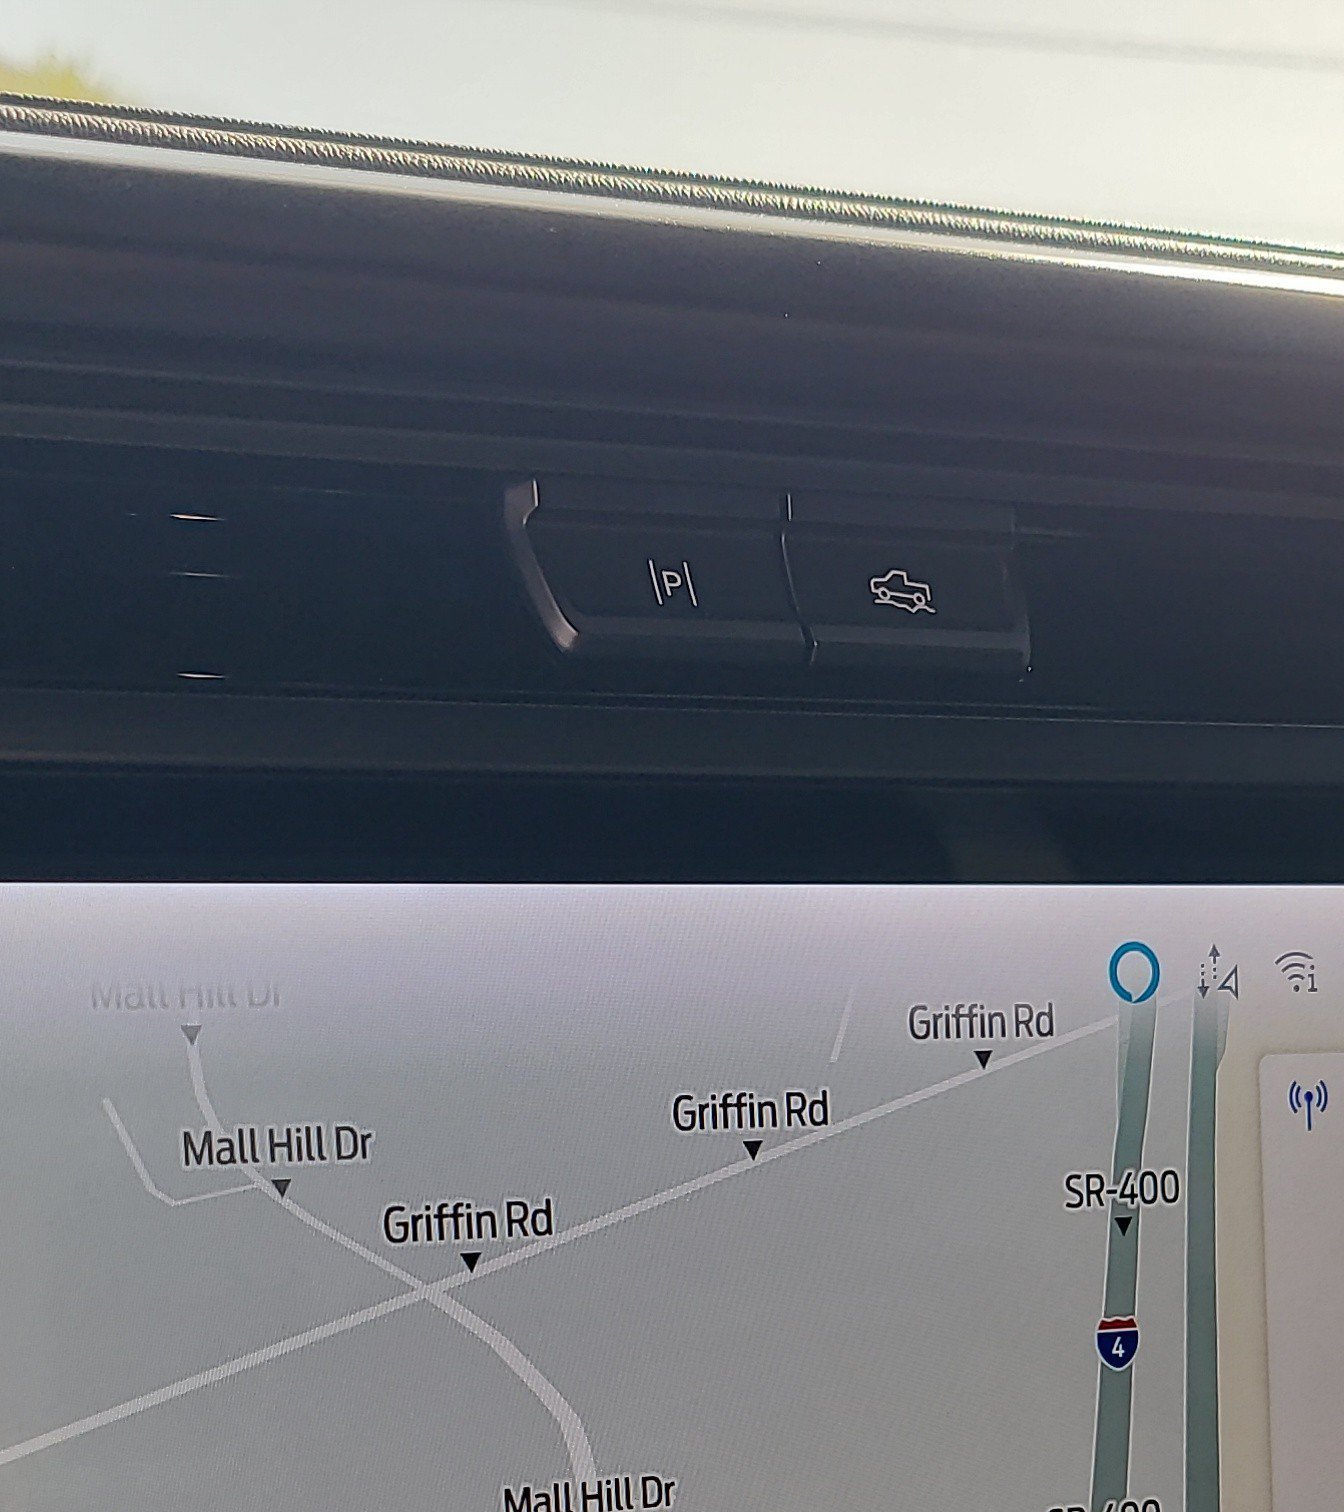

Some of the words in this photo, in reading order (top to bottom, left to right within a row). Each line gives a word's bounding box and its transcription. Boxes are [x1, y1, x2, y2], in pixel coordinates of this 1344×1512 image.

[907, 1003, 1008, 1041] Griffin
[1014, 1002, 1055, 1038] Rd
[672, 1093, 778, 1131] Griffin
[785, 1090, 830, 1128] Rd
[182, 1129, 260, 1167] Mall
[267, 1126, 328, 1163] Hill
[334, 1126, 374, 1161] Dr
[1063, 1169, 1181, 1209] SR-400
[382, 1202, 498, 1245] Griffin
[505, 1197, 555, 1239] Rd
[1111, 1337, 1125, 1359] 4
[641, 1476, 677, 1509] Dr
